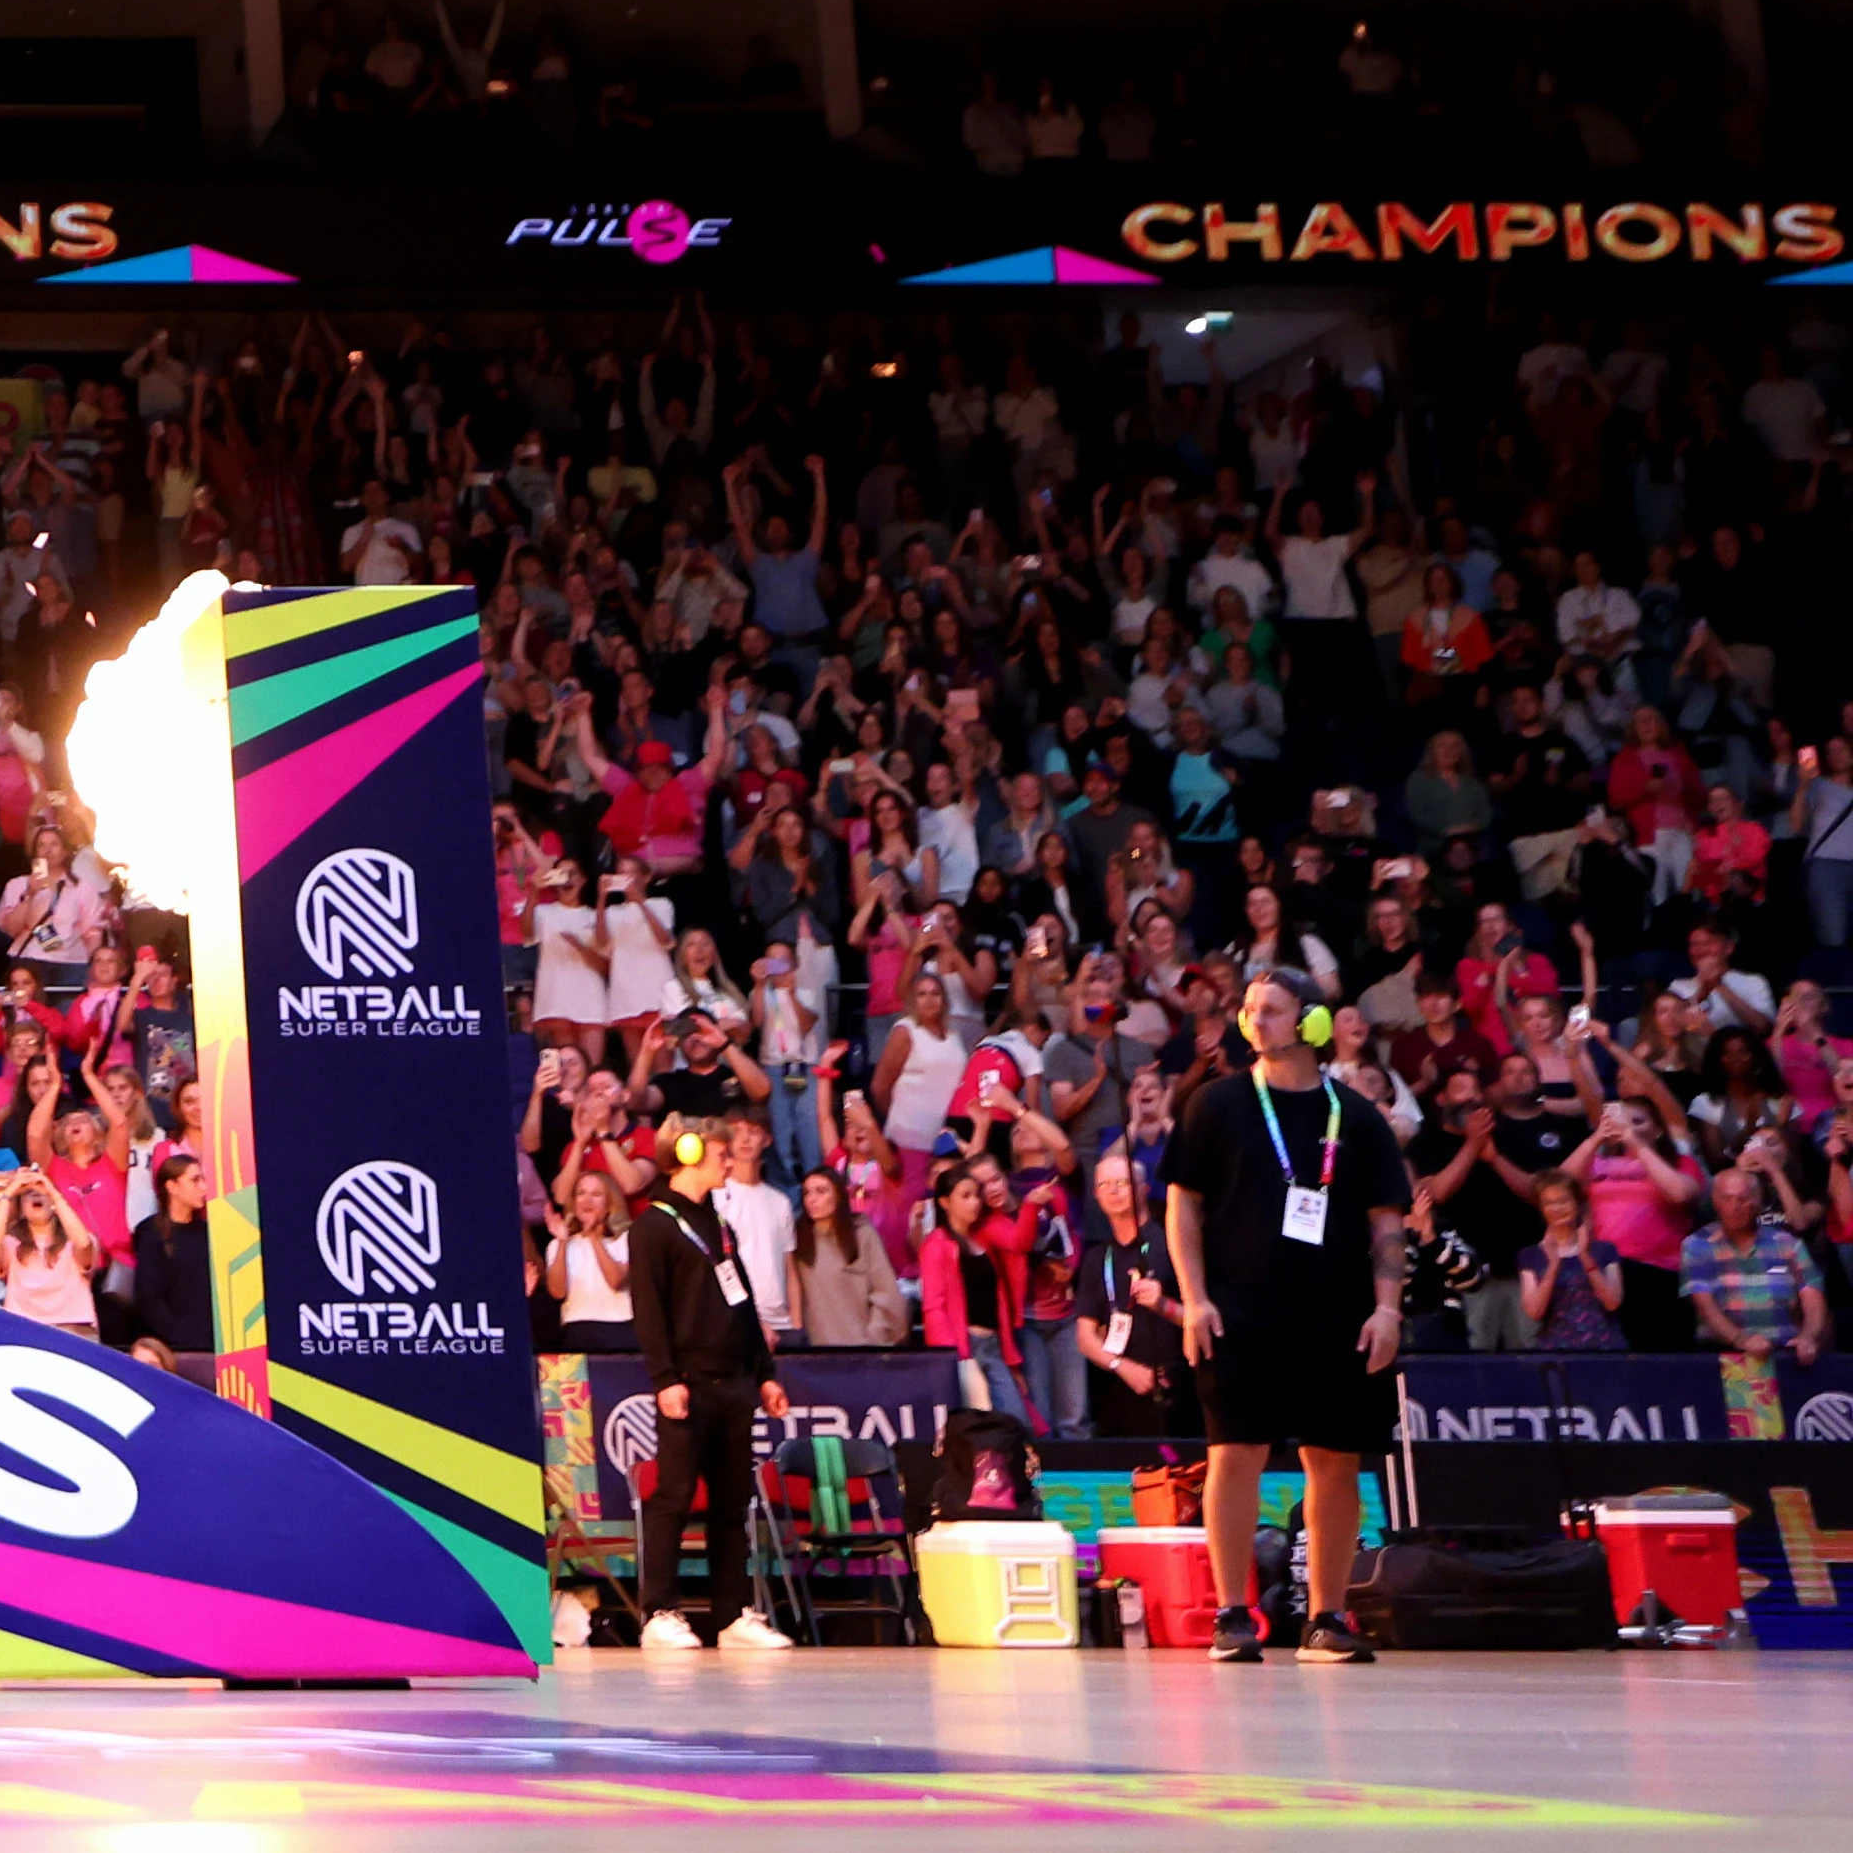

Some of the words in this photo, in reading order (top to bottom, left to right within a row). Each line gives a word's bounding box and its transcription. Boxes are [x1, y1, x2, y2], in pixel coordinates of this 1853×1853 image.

[505, 209, 732, 256] PULSE
[1121, 201, 1844, 263] CHAMPIONS
[278, 986, 480, 1021] NETBALL
[280, 1021, 368, 1037] SUPER
[376, 1021, 481, 1037] LEAGUE
[299, 1301, 504, 1339] NETBALL
[300, 1339, 388, 1354] SUPER
[398, 1339, 504, 1354] LEAGUE
[750, 1404, 949, 1456] ETBALL
